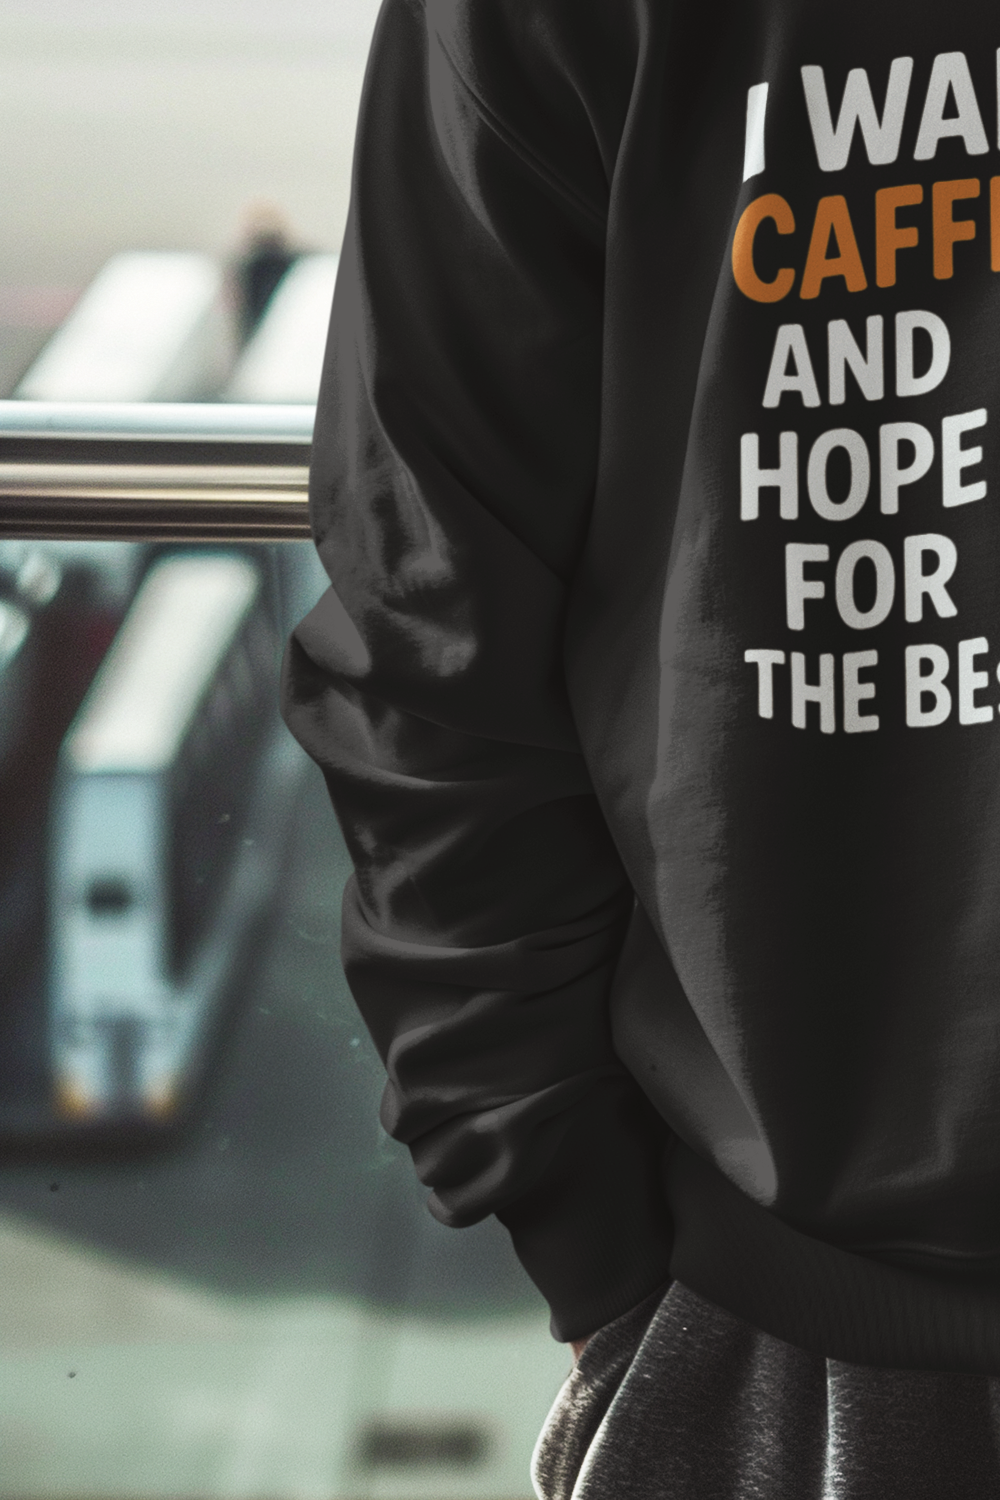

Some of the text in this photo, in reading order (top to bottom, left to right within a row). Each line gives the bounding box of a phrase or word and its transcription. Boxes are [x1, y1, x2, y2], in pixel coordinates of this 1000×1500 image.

[743, 82, 769, 183] I
[763, 310, 950, 407] AND
[741, 408, 987, 521] HOPE
[786, 534, 957, 630] FOR
[745, 649, 879, 733] THE
